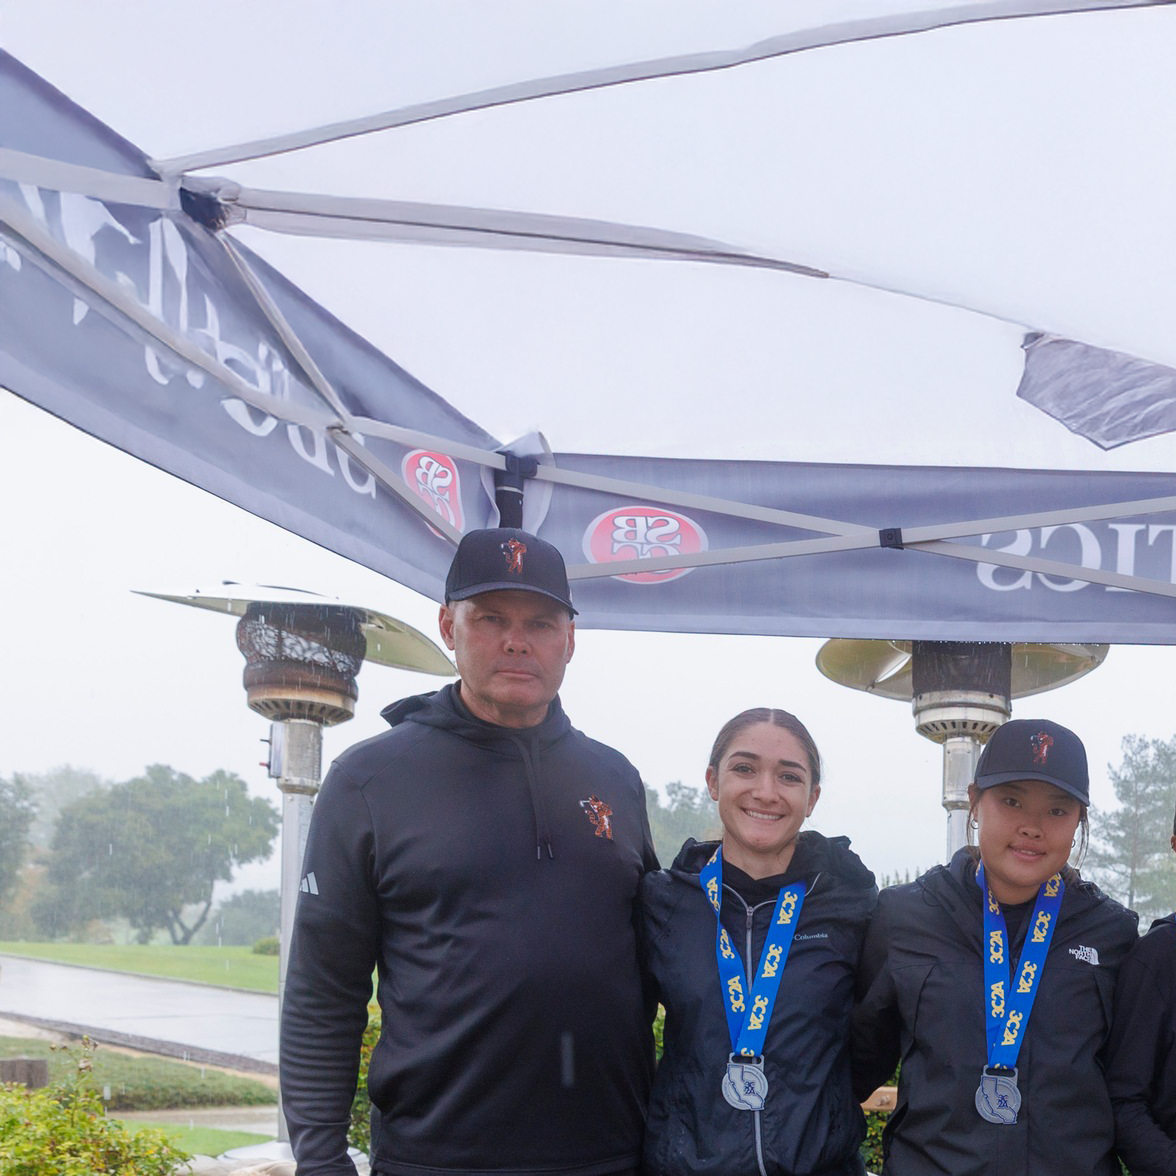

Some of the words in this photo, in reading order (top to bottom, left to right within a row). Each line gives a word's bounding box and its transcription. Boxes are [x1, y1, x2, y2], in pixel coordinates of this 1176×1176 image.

[777, 891, 798, 924] 3C2A
[988, 887, 1000, 915] 3C
[1031, 911, 1051, 943] 3C2A
[761, 944, 783, 978] 3C2A
[990, 930, 1004, 964] 3C2A
[727, 976, 745, 1012] 3C2A
[1017, 961, 1037, 993] 3C2A
[747, 995, 768, 1030] 3C2A
[991, 981, 1005, 1018] 3C2A
[1001, 1010, 1023, 1046] 3C2A
